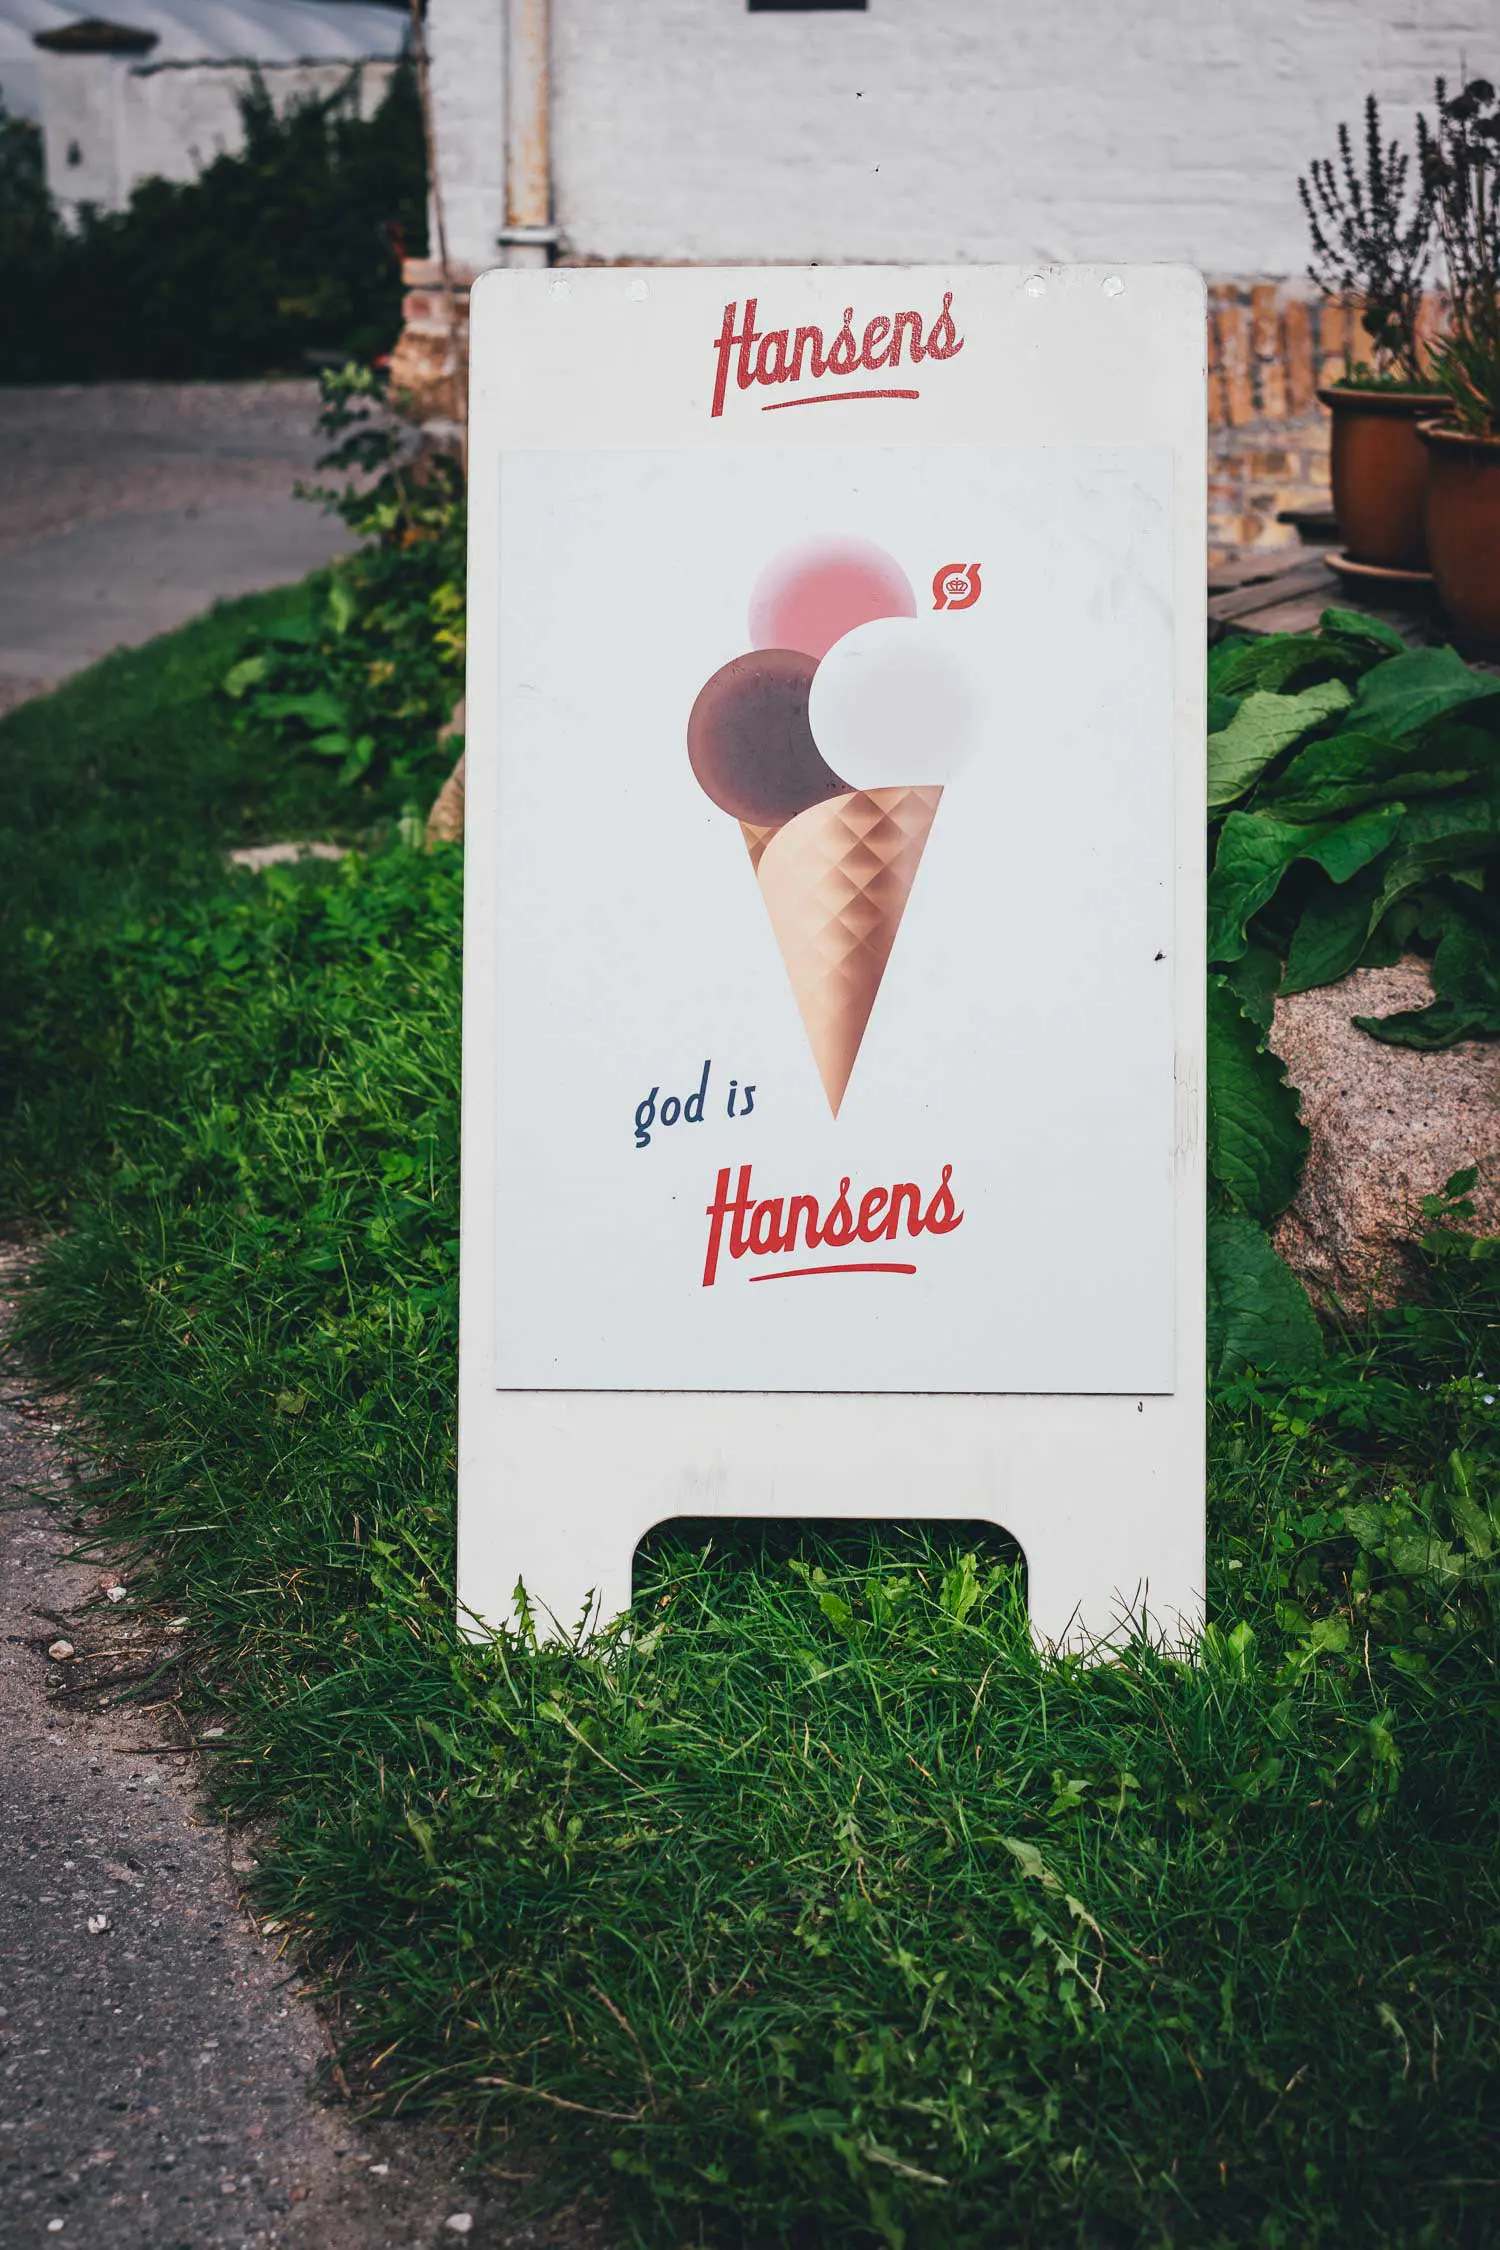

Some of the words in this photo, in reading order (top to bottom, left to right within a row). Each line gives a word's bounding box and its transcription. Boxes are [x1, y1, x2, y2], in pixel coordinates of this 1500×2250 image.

[711, 292, 965, 418] Hansens
[633, 1059, 712, 1149] god
[726, 1079, 757, 1119] is
[702, 1164, 965, 1288] Hansens
